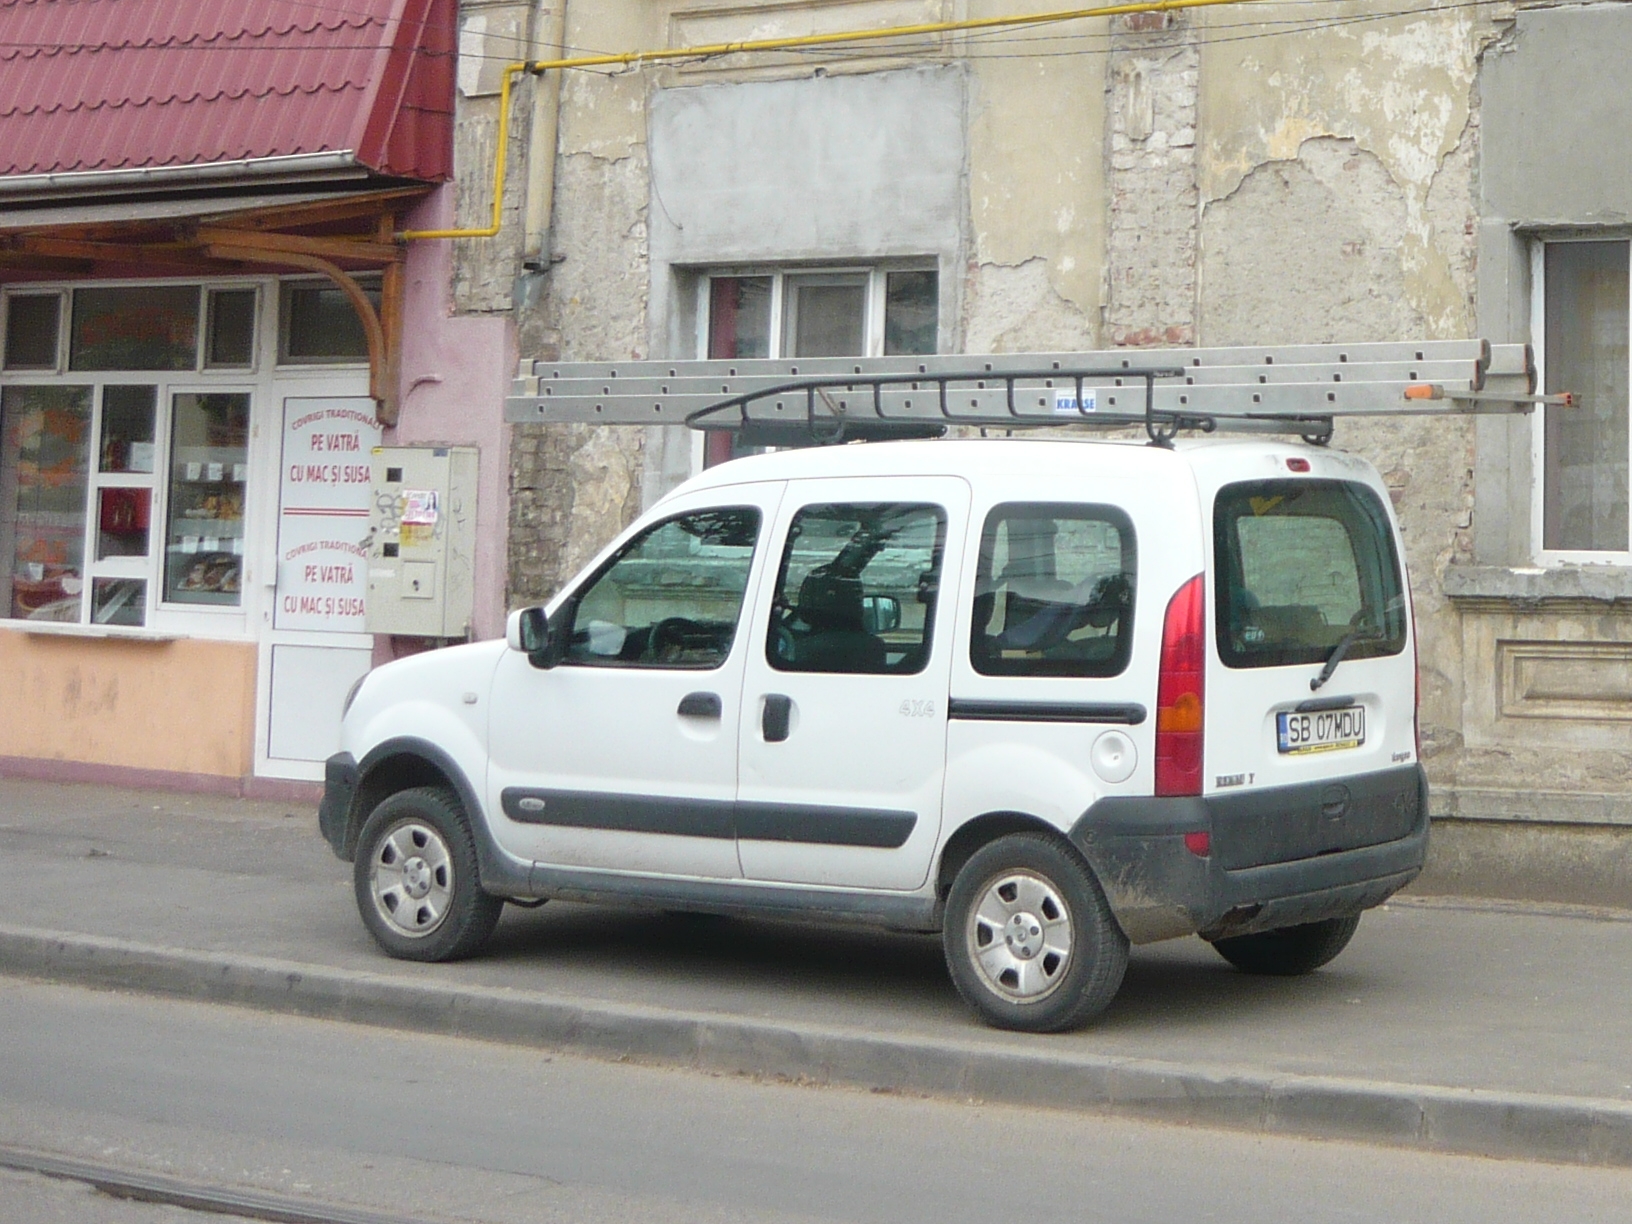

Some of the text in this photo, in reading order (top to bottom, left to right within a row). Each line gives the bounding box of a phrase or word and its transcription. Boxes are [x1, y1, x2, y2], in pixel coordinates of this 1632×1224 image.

[1057, 398, 1095, 409] KRASE
[292, 411, 324, 430] COVRIGI
[311, 434, 323, 451] PE
[290, 465, 303, 482] CU
[306, 465, 328, 483] MAC
[344, 466, 371, 483] SUSA
[286, 541, 367, 561] COVRIGI TRADIȚIONA
[305, 565, 317, 582] PE
[284, 596, 297, 613] CU
[301, 597, 322, 614] MAC
[338, 598, 365, 616] SUSA
[1289, 716, 1311, 743] SB
